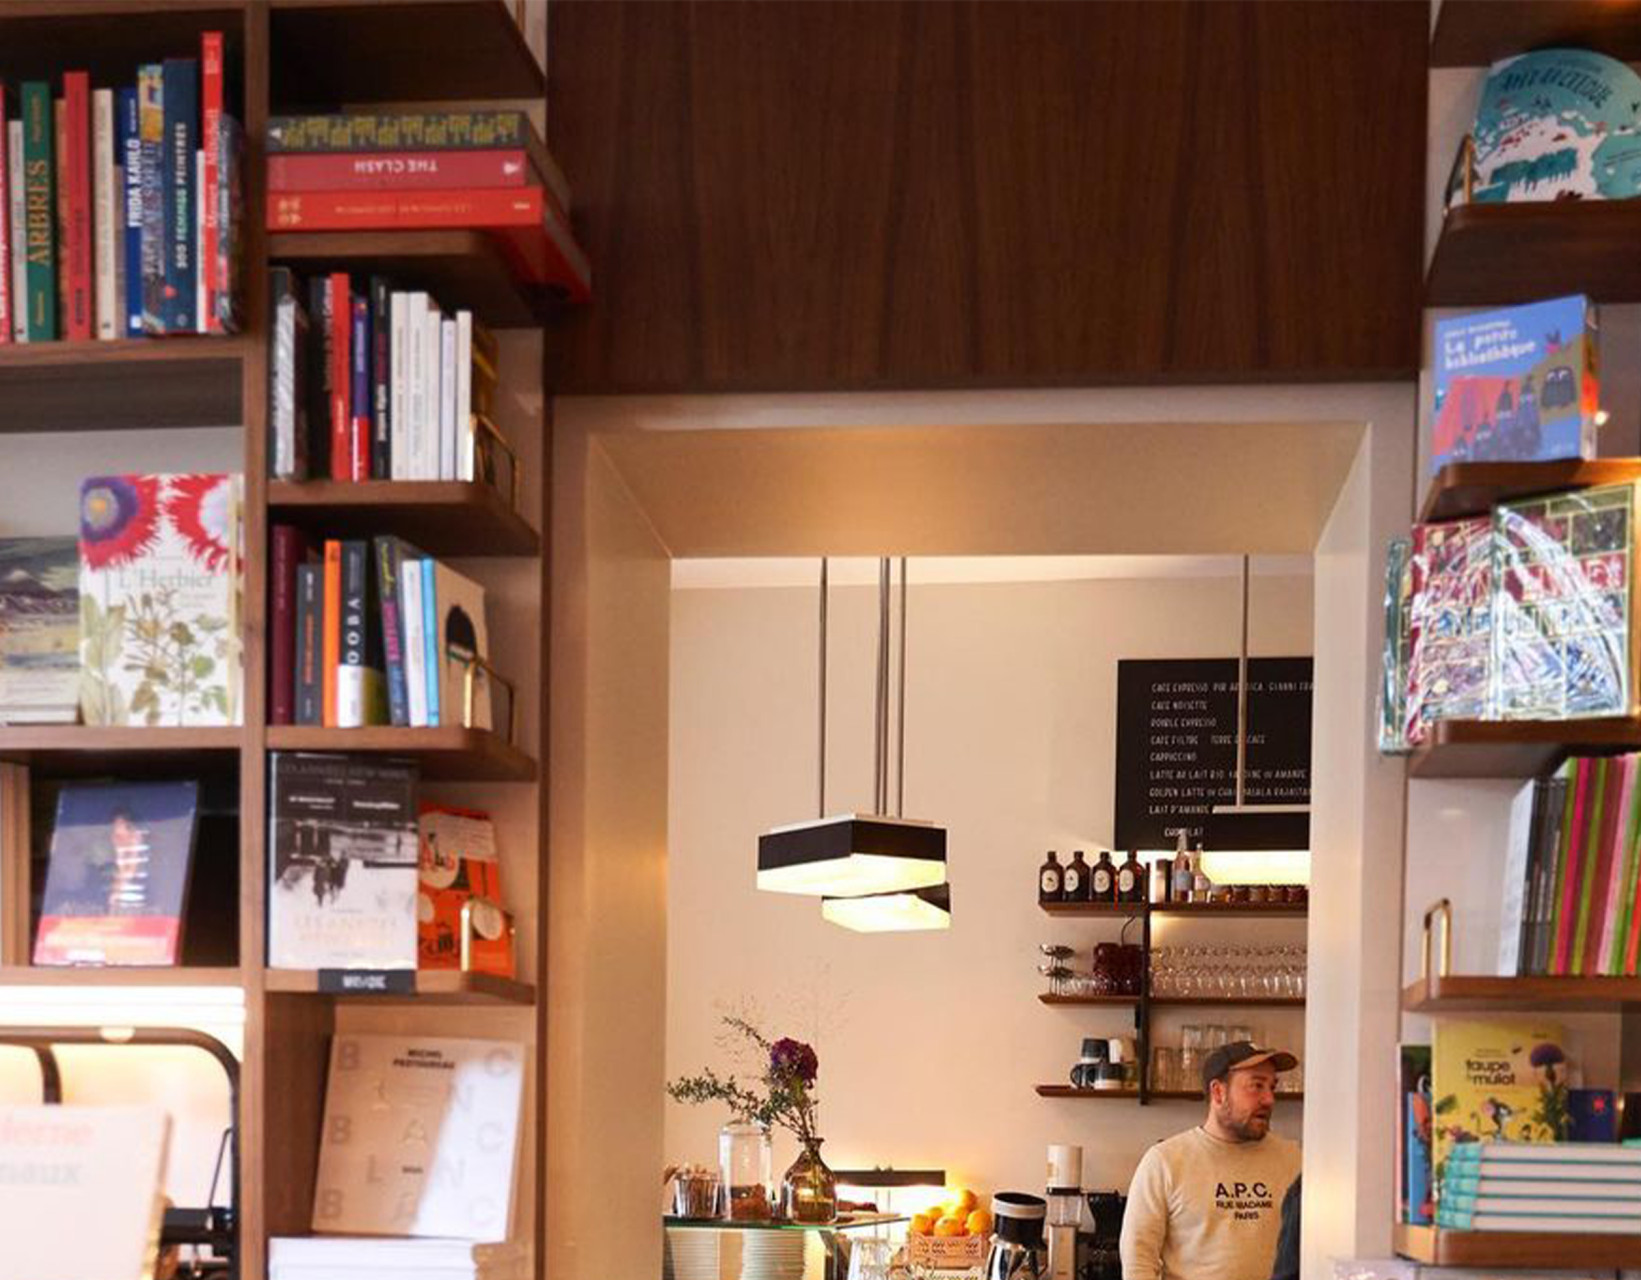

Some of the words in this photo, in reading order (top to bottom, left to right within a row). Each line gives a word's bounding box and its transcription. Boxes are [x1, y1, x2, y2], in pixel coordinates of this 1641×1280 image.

[127, 139, 141, 184] KAHLO
[354, 160, 404, 173] CLASH
[408, 160, 438, 172] THE
[27, 159, 50, 266] ARBRES
[127, 187, 142, 227] FRIDA
[1466, 1059, 1511, 1074] taupe
[1473, 1072, 1516, 1086] mulot
[1215, 1182, 1272, 1199] A.P.C.
[1216, 1200, 1233, 1209] RUE
[1235, 1200, 1273, 1209] MADAME
[1234, 1211, 1259, 1221] PARIS
